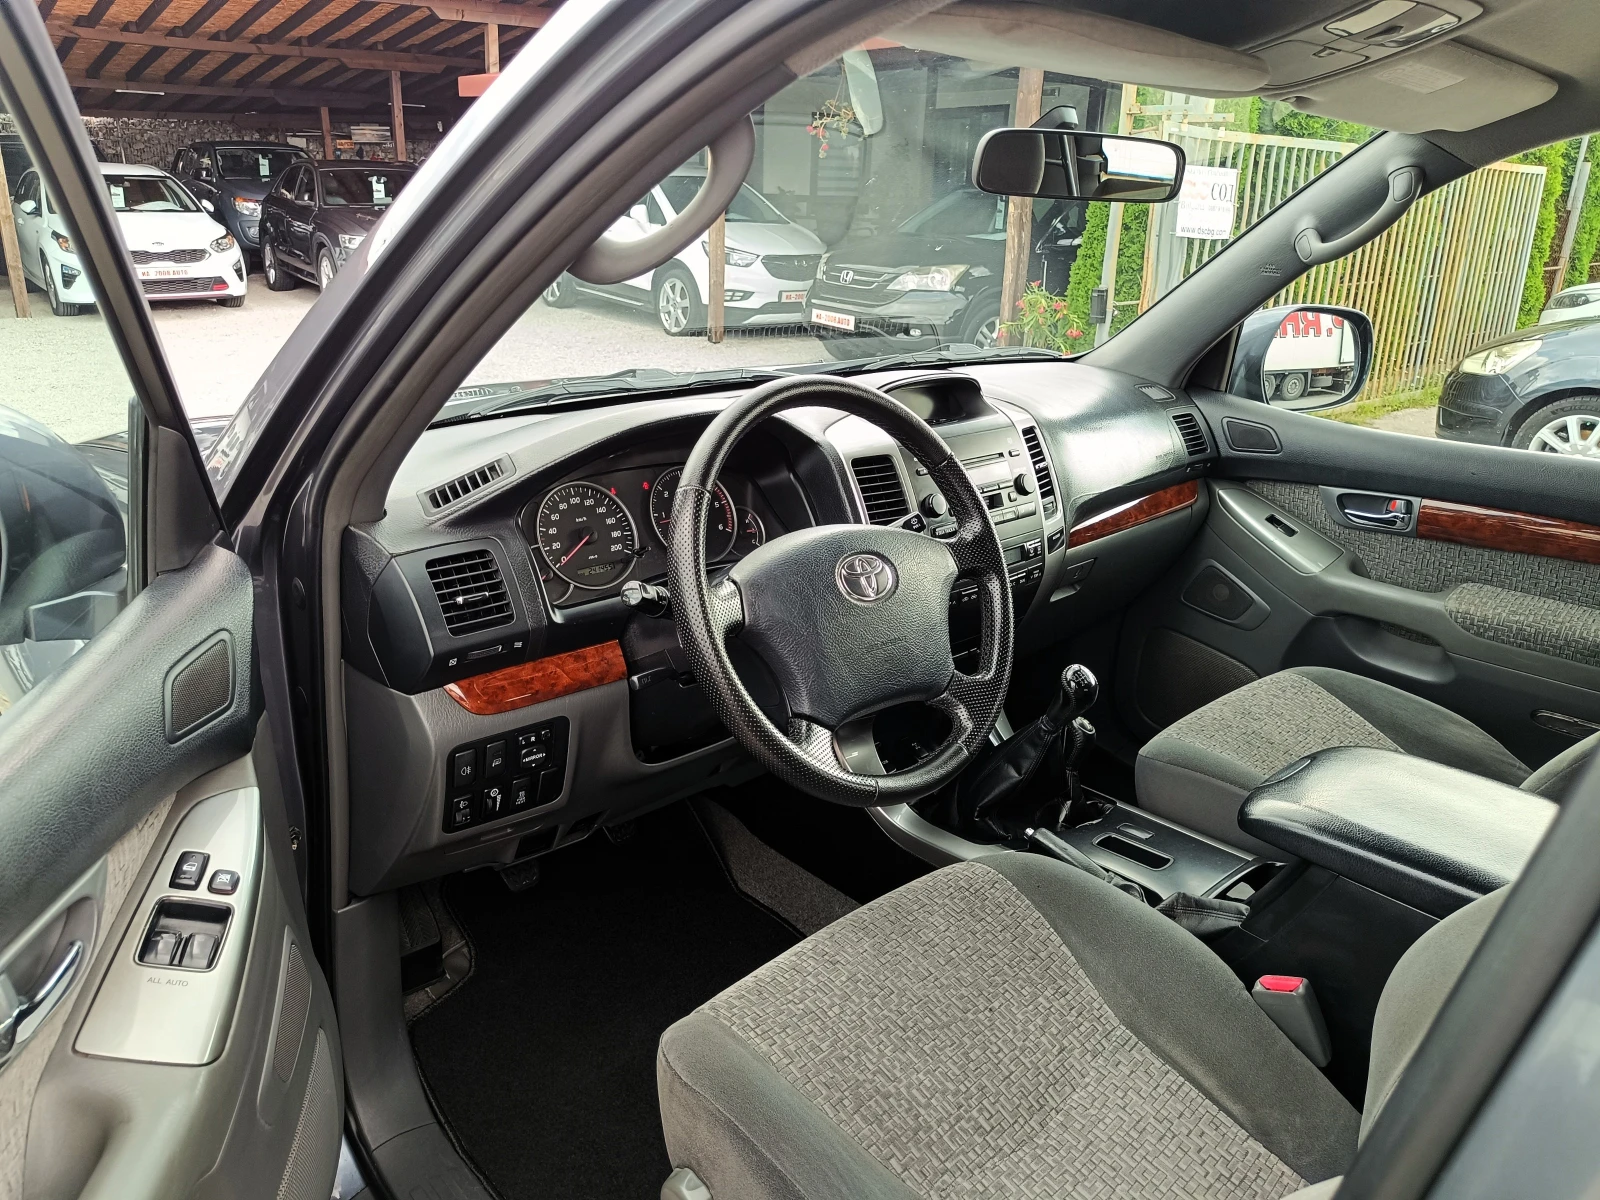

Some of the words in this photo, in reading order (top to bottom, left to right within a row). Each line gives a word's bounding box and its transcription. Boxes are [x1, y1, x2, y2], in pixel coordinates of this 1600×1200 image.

[596, 506, 607, 514] 140
[550, 513, 560, 521] 60
[605, 517, 616, 525] 160
[548, 527, 557, 535] 40
[718, 523, 724, 531] 6
[611, 530, 622, 538] 180
[552, 542, 561, 550] 20
[610, 543, 622, 552] 200
[146, 976, 162, 985] ALL
[165, 978, 189, 987] AUTO
